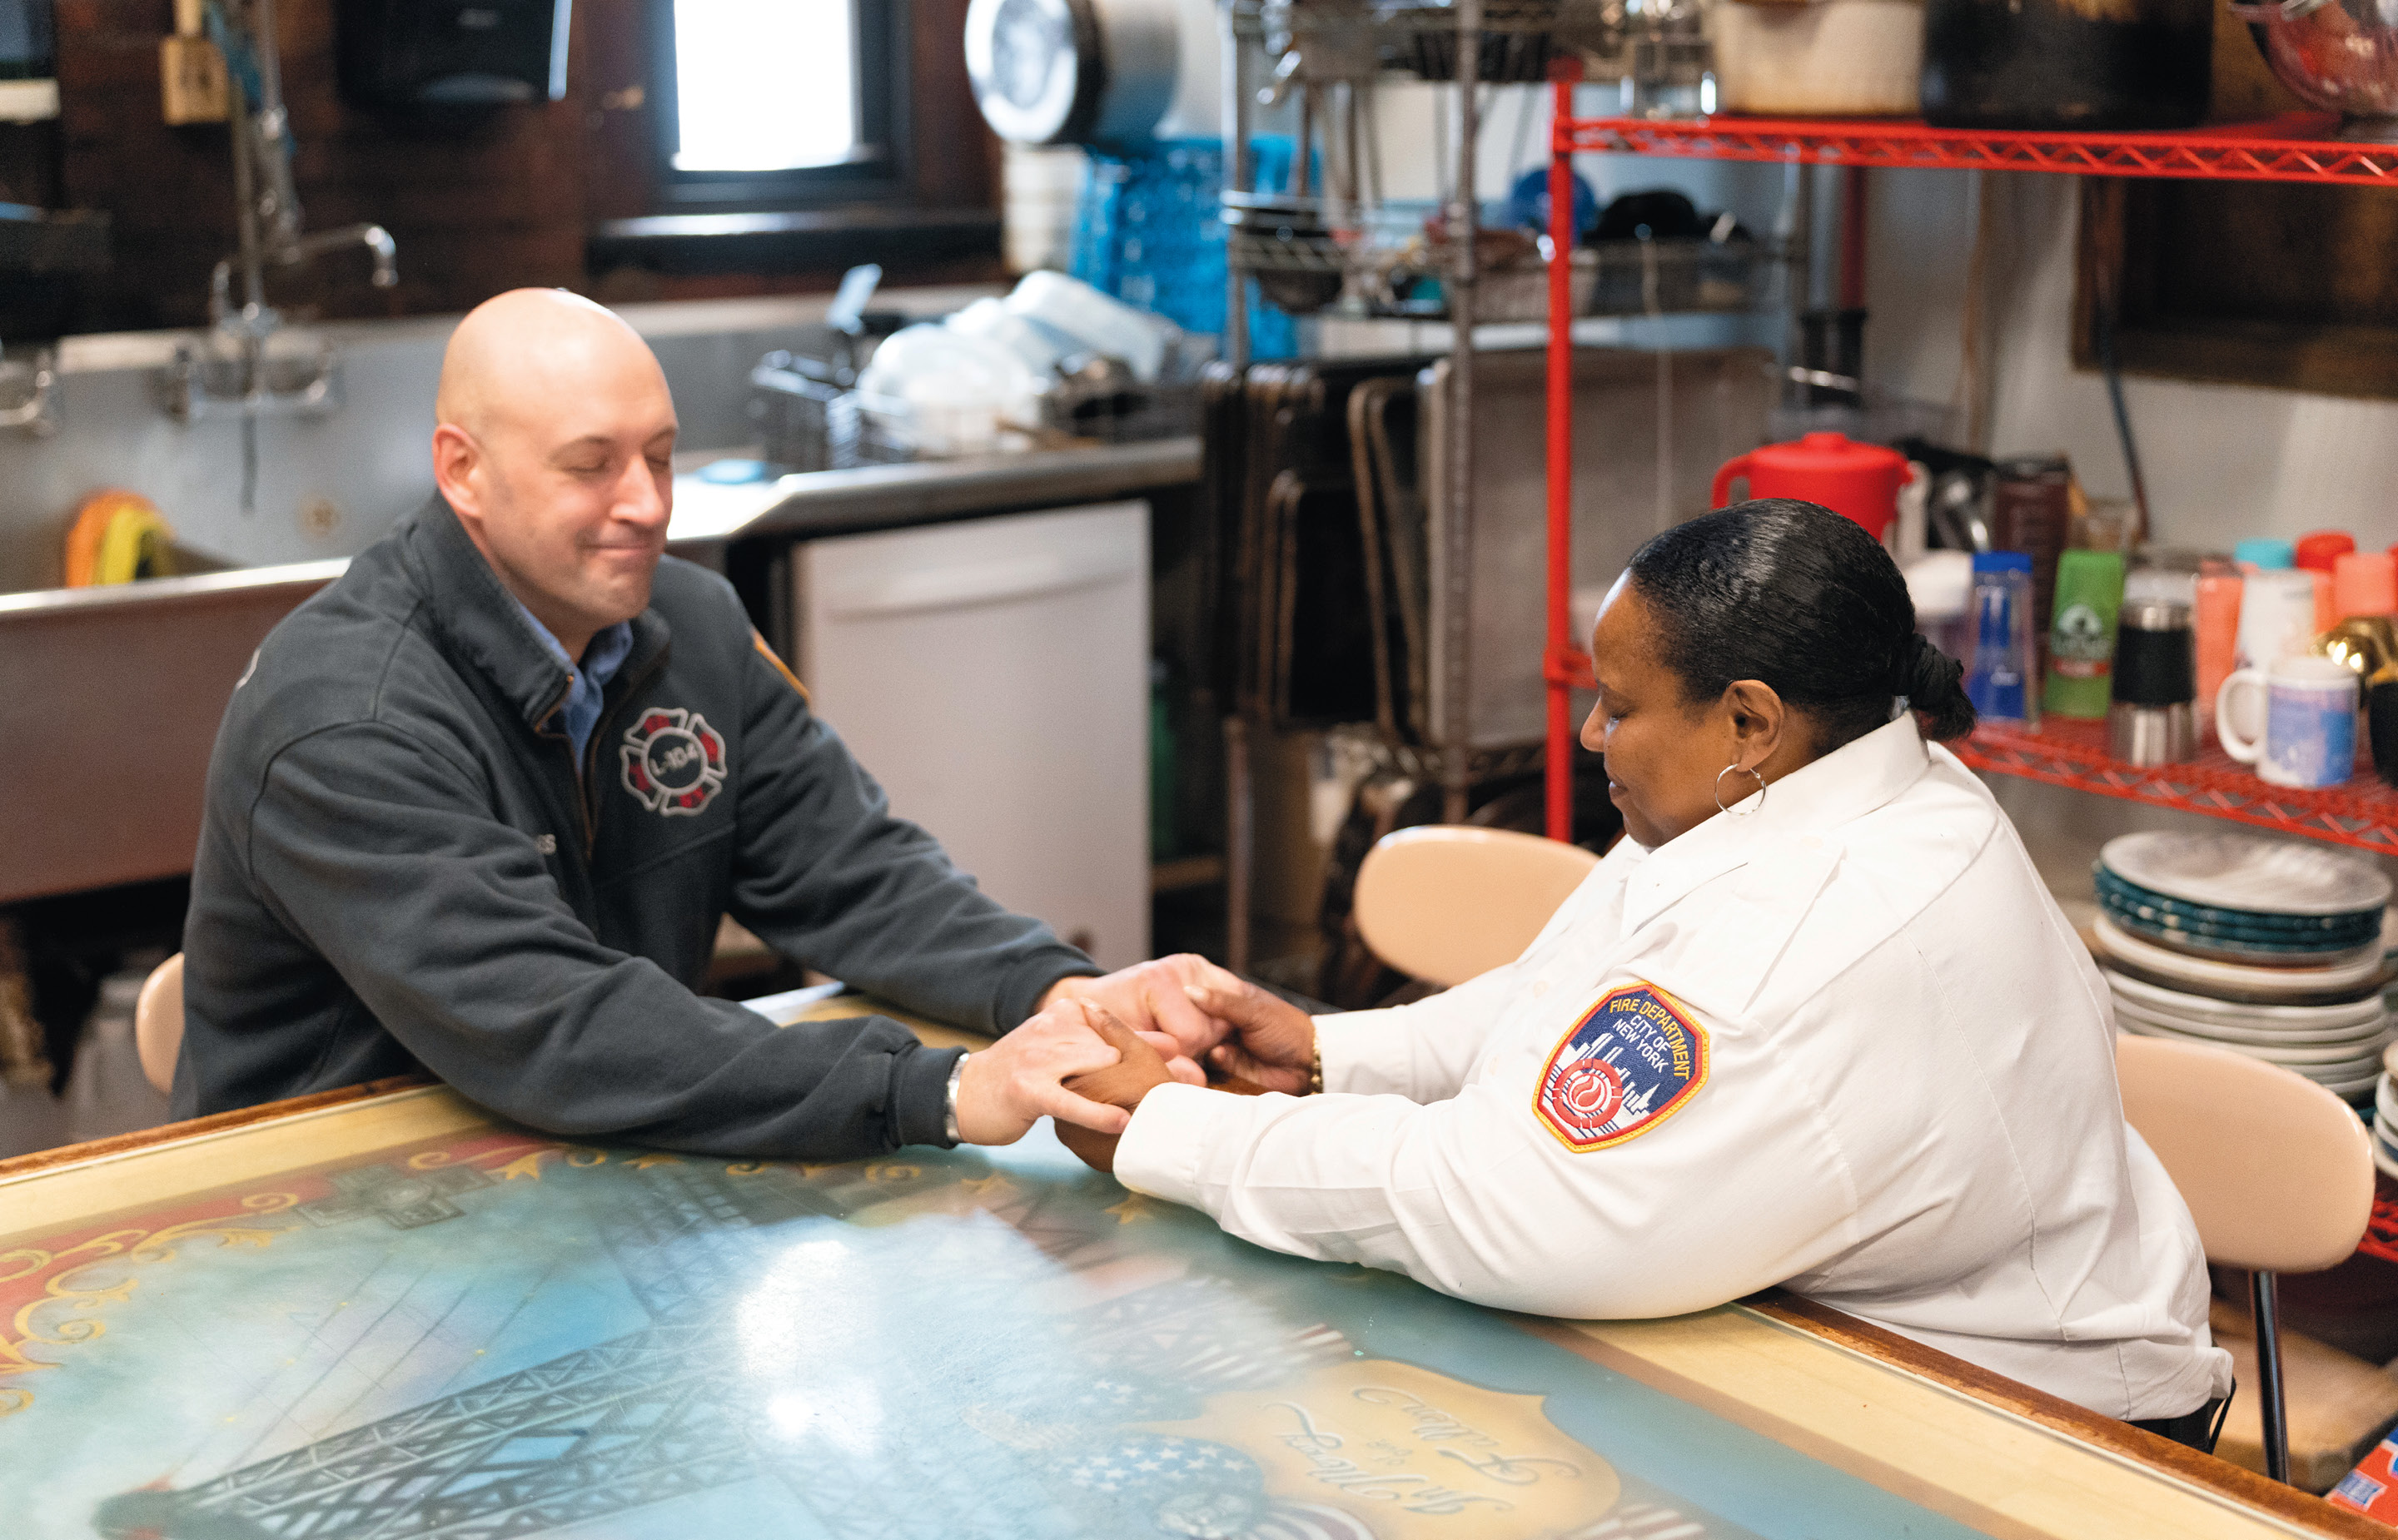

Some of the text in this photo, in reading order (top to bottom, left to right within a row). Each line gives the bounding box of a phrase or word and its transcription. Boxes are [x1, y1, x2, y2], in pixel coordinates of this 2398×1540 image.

[649, 742, 699, 777] L-104
[1609, 998, 1690, 1080] FIRE DEPARTMENT
[1613, 1018, 1669, 1074] NEW YORK
[1629, 1015, 1672, 1052] CITY OF
